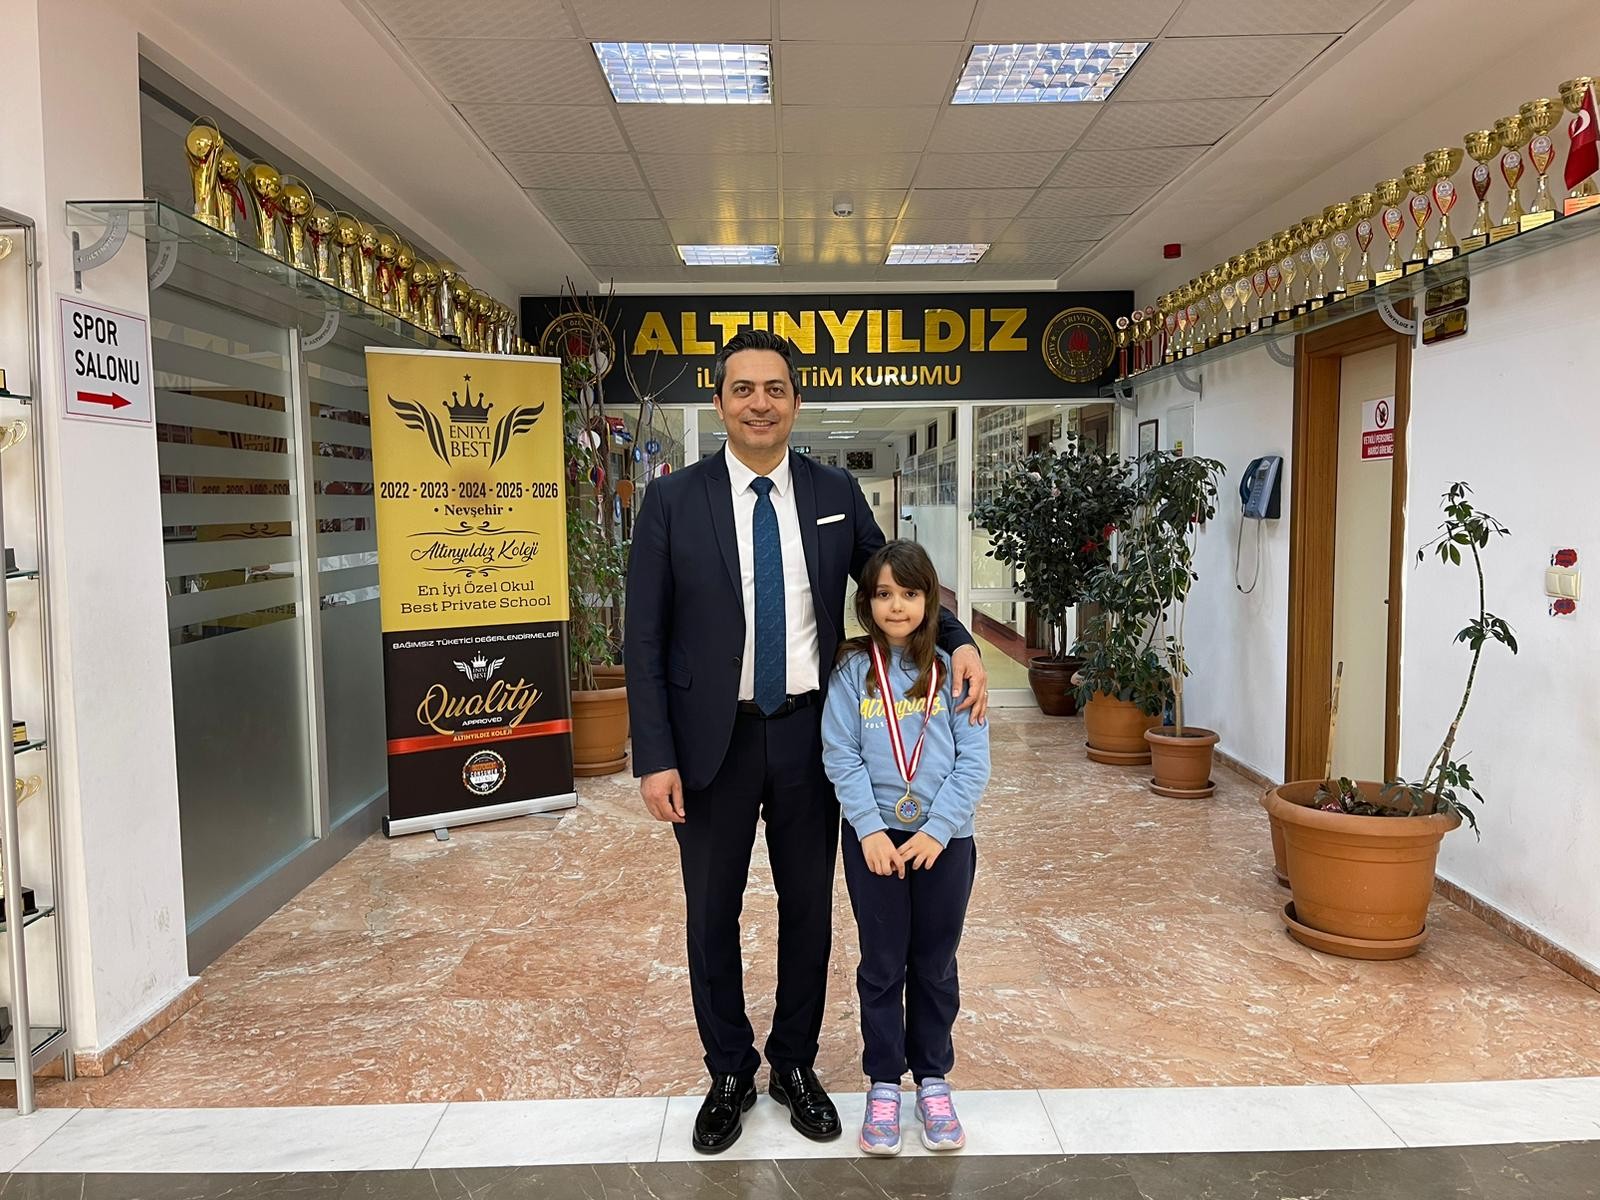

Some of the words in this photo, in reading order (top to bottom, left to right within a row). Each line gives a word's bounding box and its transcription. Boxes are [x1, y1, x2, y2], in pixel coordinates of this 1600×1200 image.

[72, 311, 118, 347] SPOR
[74, 349, 140, 385] SALONU
[851, 365, 961, 387] KURUMU
[449, 425, 490, 440] ENIYI
[451, 441, 491, 457] BEST
[380, 481, 410, 499] 2022
[420, 481, 449, 499] 2023
[458, 481, 487, 499] 2024
[496, 482, 523, 499] 2025
[532, 482, 558, 499] 2026
[444, 504, 504, 517] Nevşehir
[497, 540, 539, 562] Koleji
[418, 585, 439, 597] En
[464, 580, 498, 595] Özel
[500, 580, 535, 593] Okul
[400, 602, 438, 614] Best
[441, 599, 497, 612] Private
[500, 595, 551, 608] School
[416, 677, 543, 735] Quality
[462, 717, 502, 726] APPROVED
